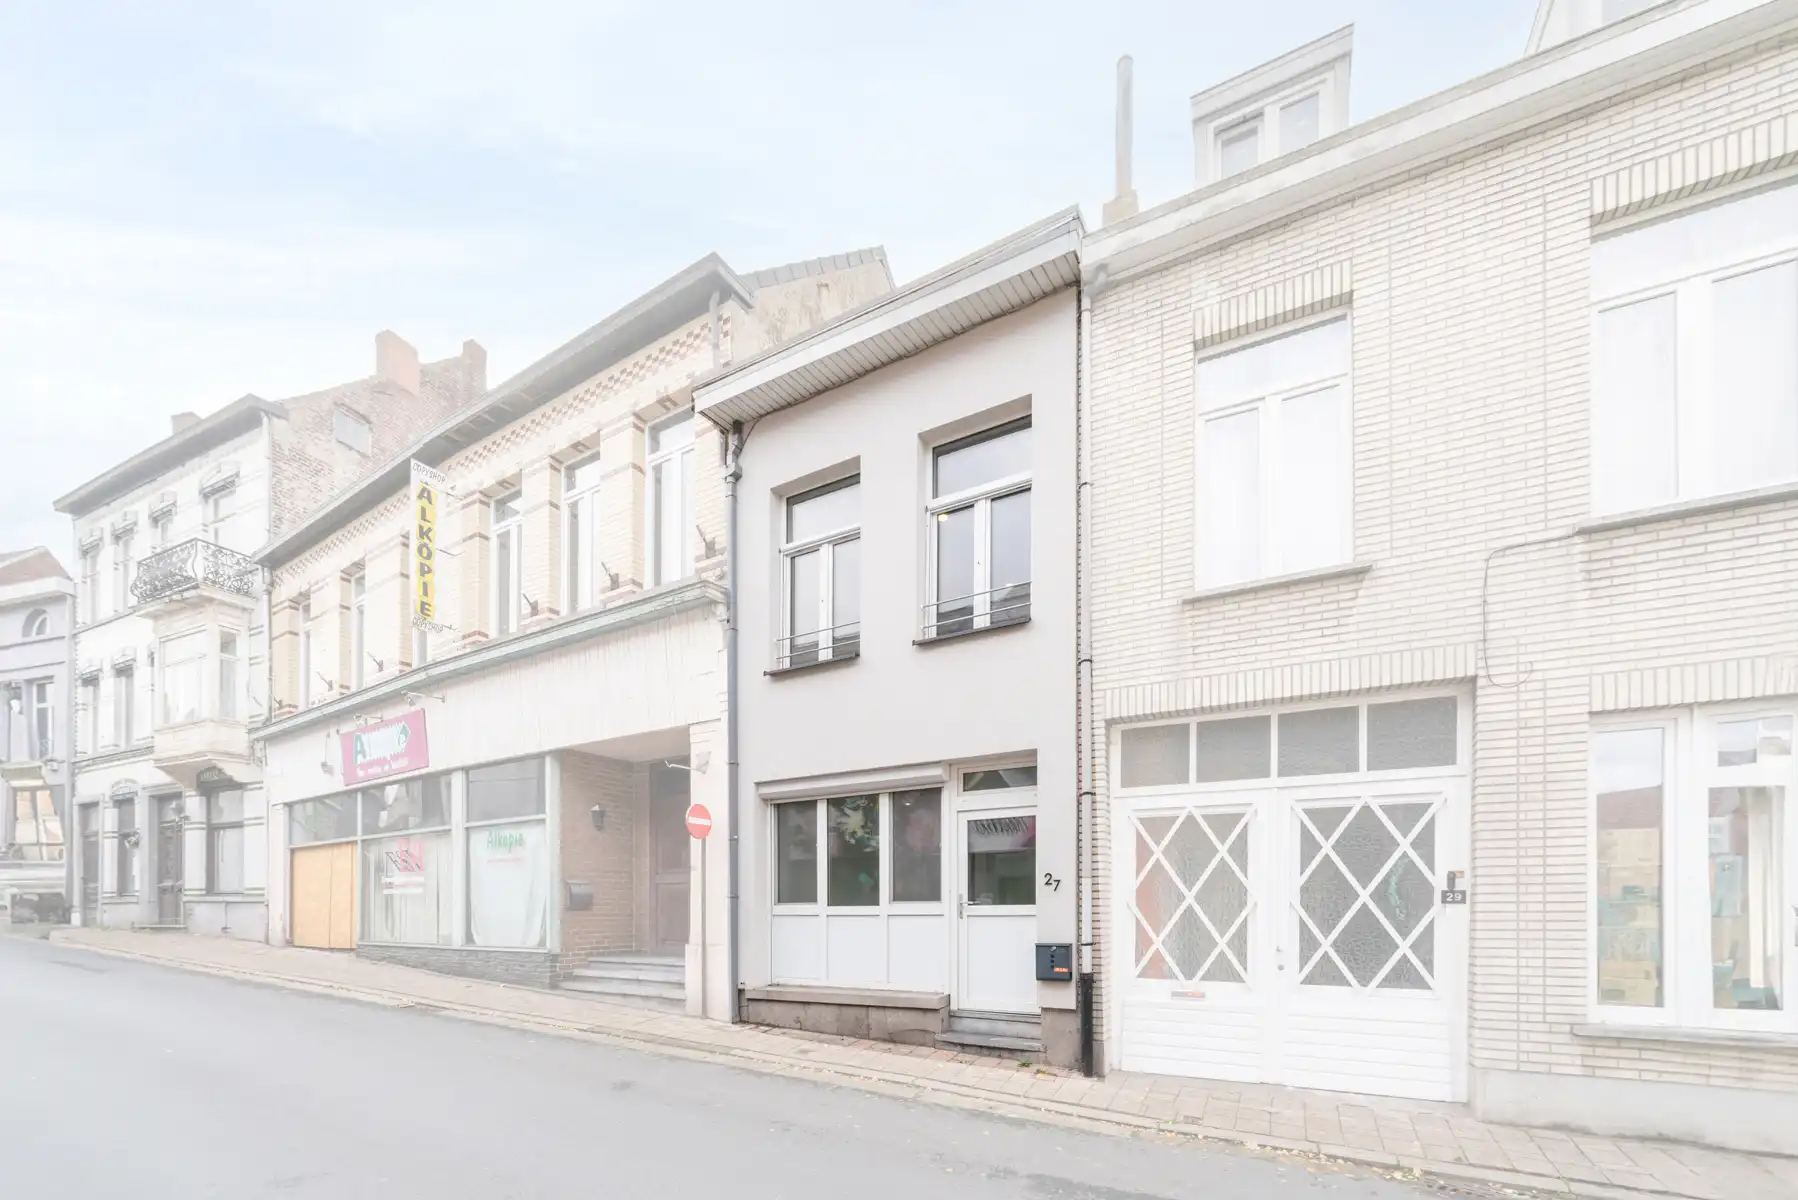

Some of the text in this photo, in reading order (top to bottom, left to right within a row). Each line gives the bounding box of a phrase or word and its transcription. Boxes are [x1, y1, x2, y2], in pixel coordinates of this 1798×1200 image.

[412, 462, 446, 484] COPYSHOP
[416, 486, 434, 618] ALKOPIE
[486, 829, 524, 854] Alkopie
[1044, 872, 1061, 892] 27
[1446, 892, 1462, 902] 29
